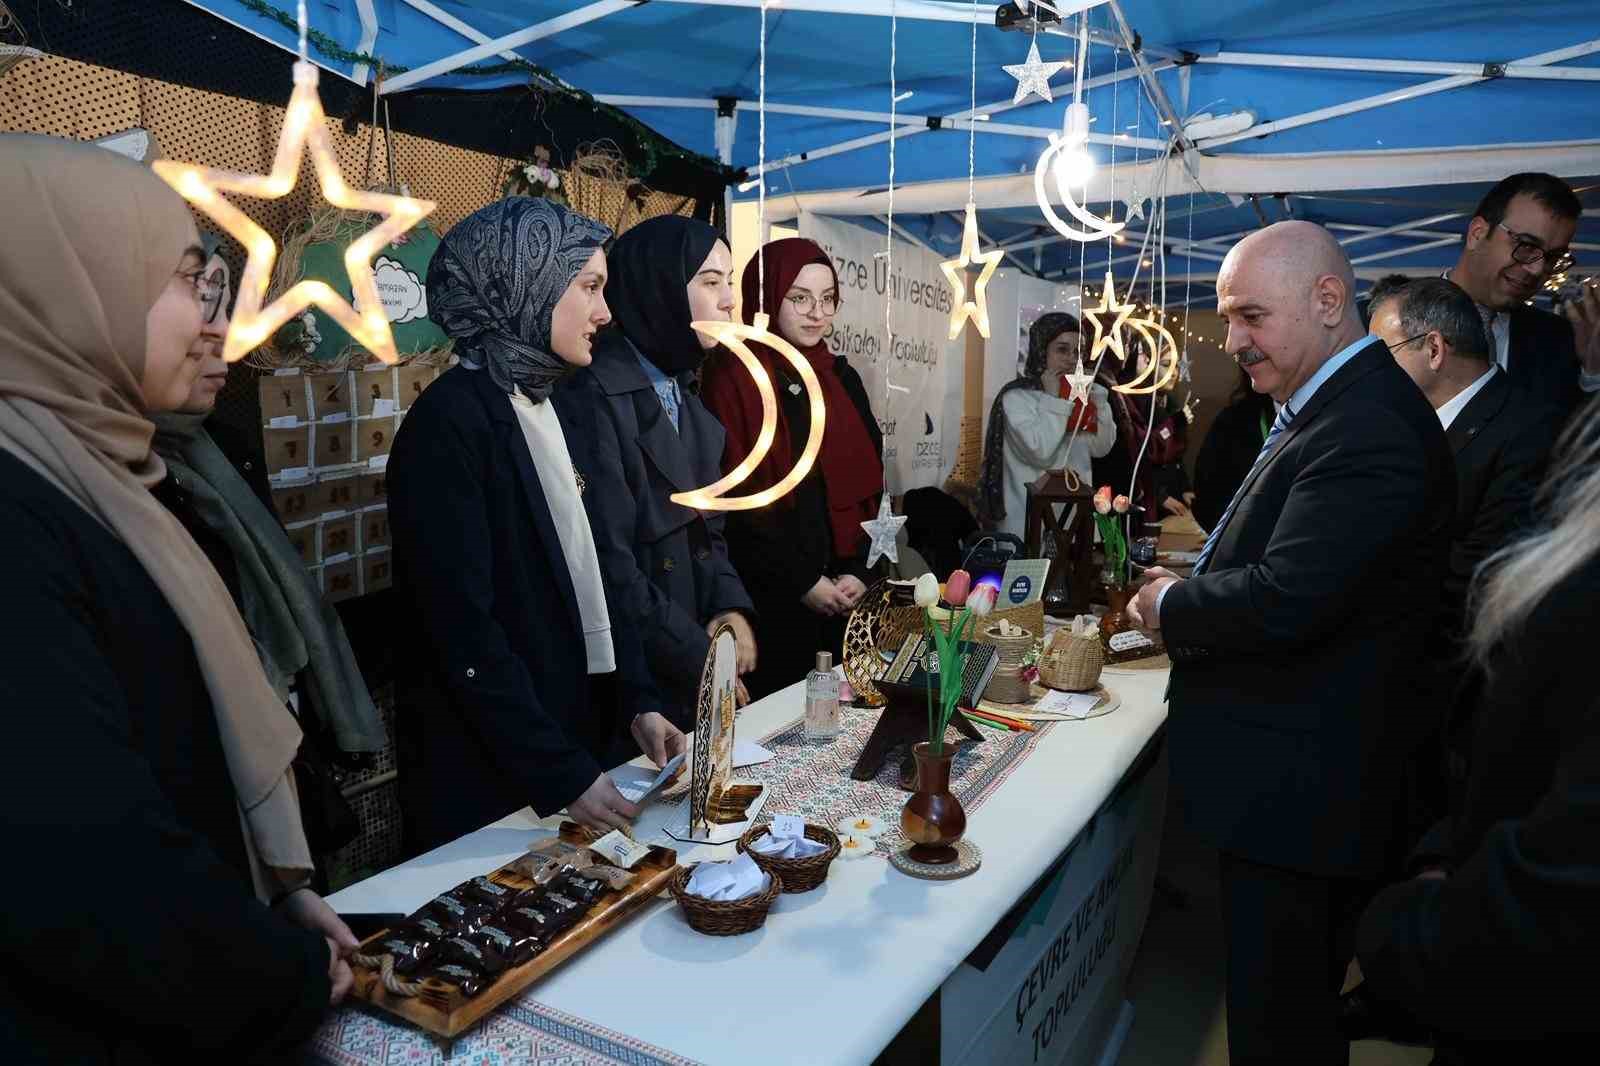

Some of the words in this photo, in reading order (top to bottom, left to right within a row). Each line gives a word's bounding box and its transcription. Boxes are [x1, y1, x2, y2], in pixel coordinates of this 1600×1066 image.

[825, 244, 867, 290] zce
[874, 255, 952, 314] Üniversites
[372, 430, 384, 448] 9
[1015, 922, 1073, 1034] ÇEVRE
